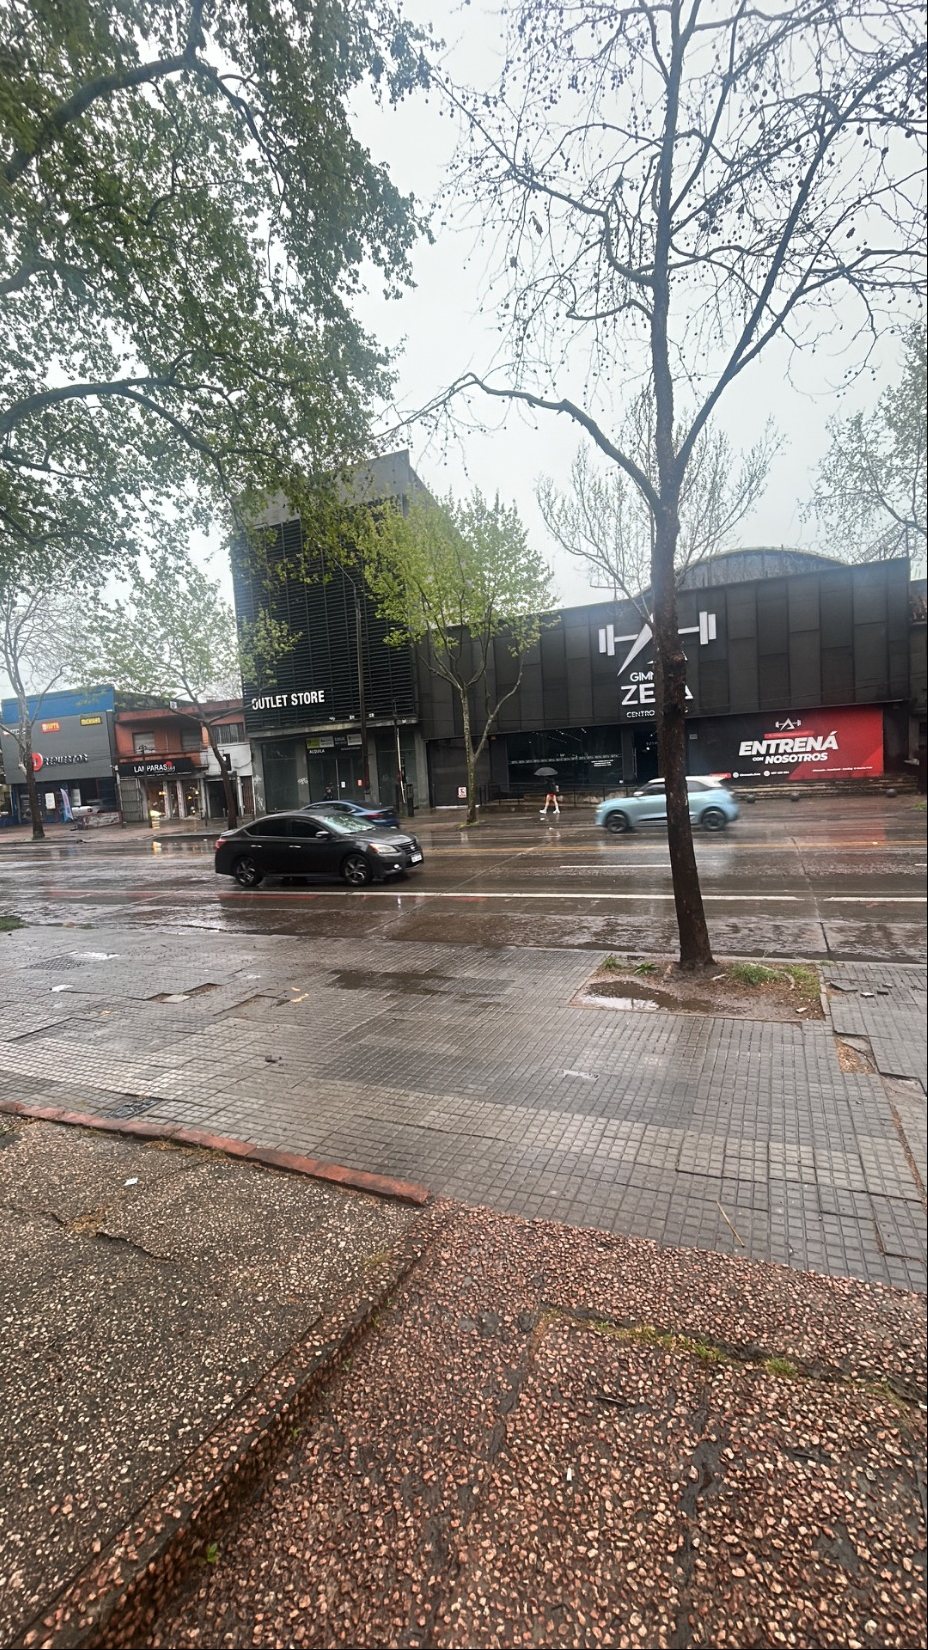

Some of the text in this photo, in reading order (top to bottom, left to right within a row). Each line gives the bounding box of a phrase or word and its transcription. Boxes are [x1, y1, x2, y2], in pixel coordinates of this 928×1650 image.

[251, 690, 325, 710] OUTLET STORE
[626, 710, 656, 718] CENTRO
[739, 731, 839, 756] ENTRENÁ
[765, 752, 828, 764] NOSOTROS
